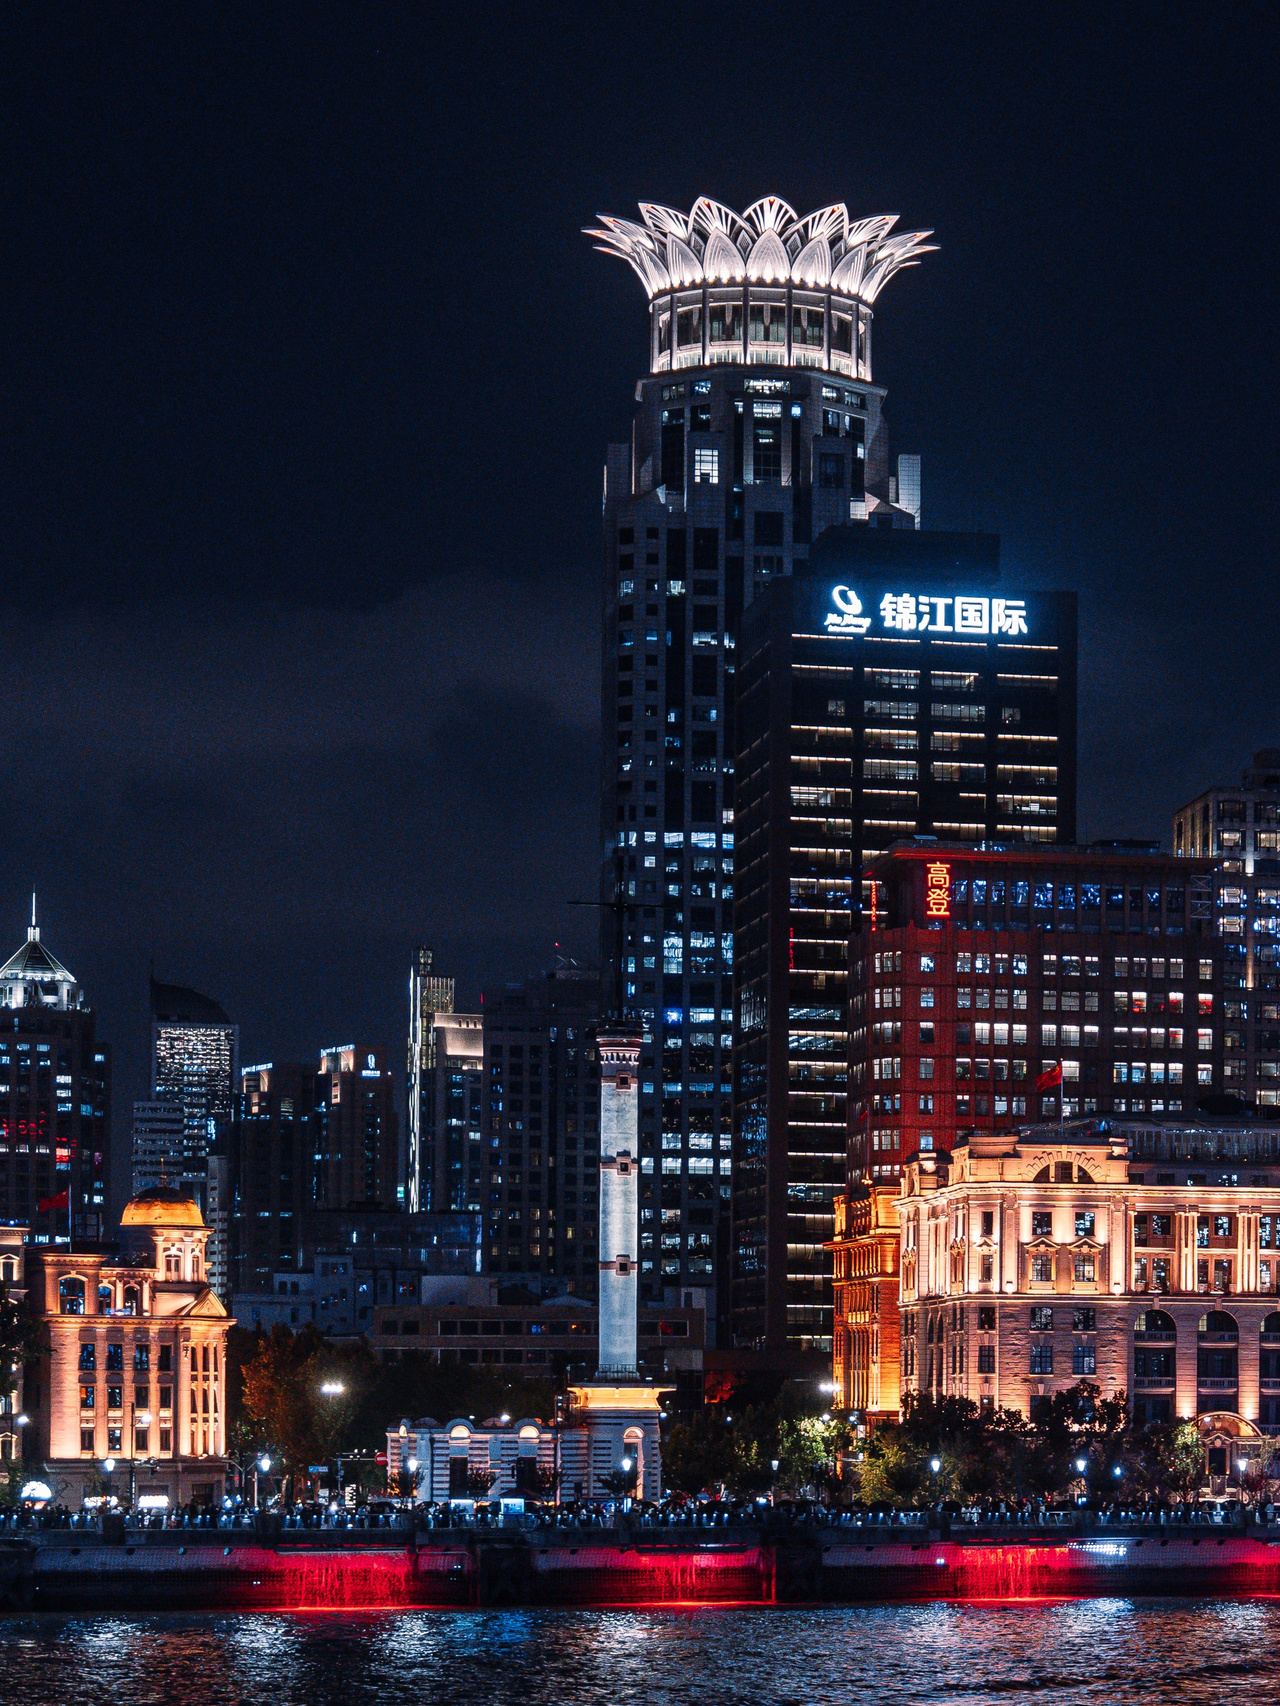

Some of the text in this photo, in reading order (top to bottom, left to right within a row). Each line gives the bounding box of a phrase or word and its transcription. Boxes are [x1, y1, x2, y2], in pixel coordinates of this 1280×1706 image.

[880, 592, 1028, 635] 锦江国际
[926, 861, 951, 918] 高登
